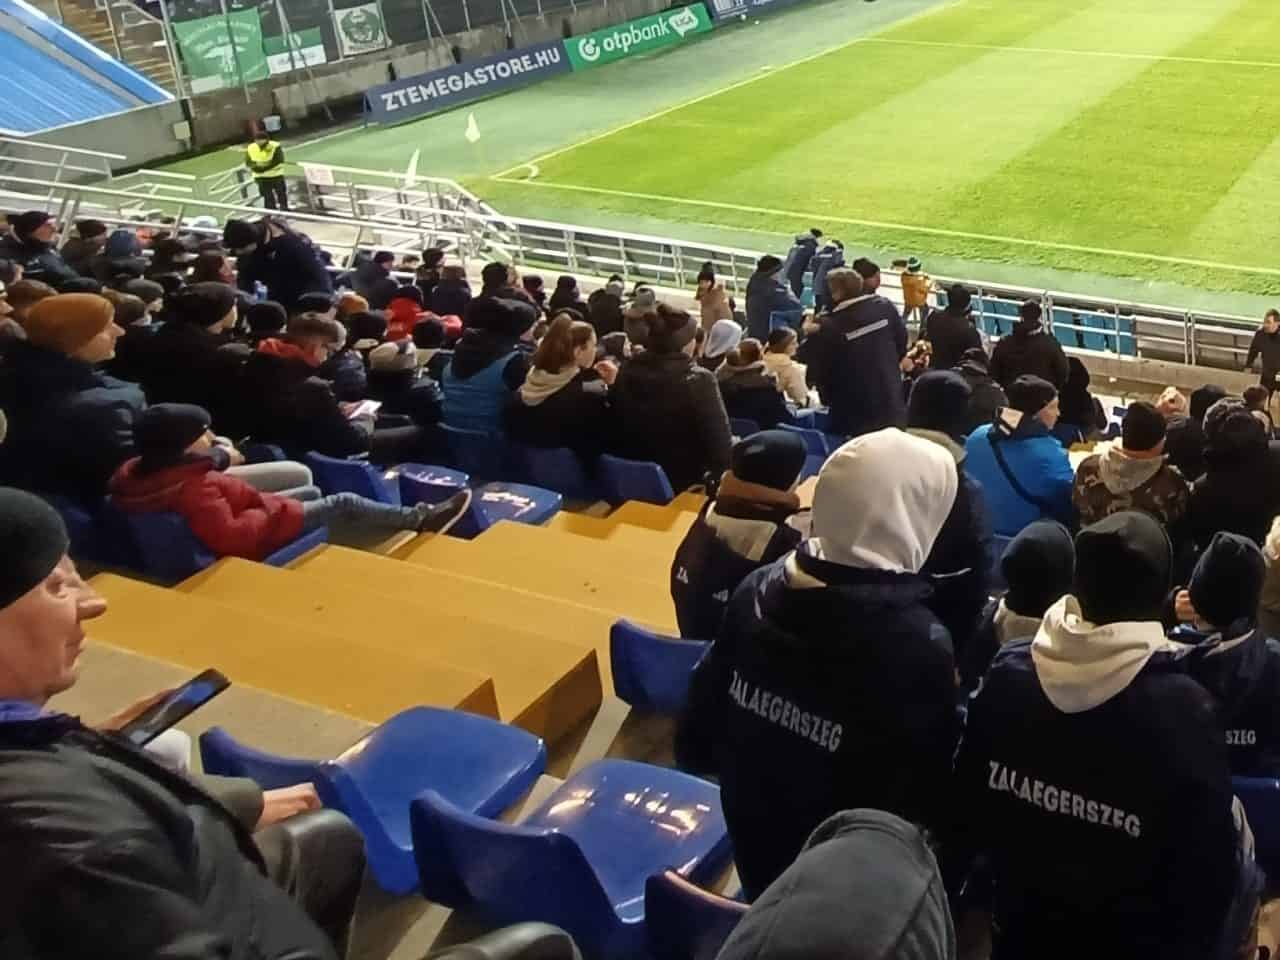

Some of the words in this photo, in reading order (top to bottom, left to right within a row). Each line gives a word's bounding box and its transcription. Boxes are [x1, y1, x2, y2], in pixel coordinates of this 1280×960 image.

[381, 48, 561, 112] ZTEMEGASTORE.HU
[728, 669, 843, 753] ZALAEGERSZEG
[988, 759, 1142, 838] ZALAEGERSZEG
